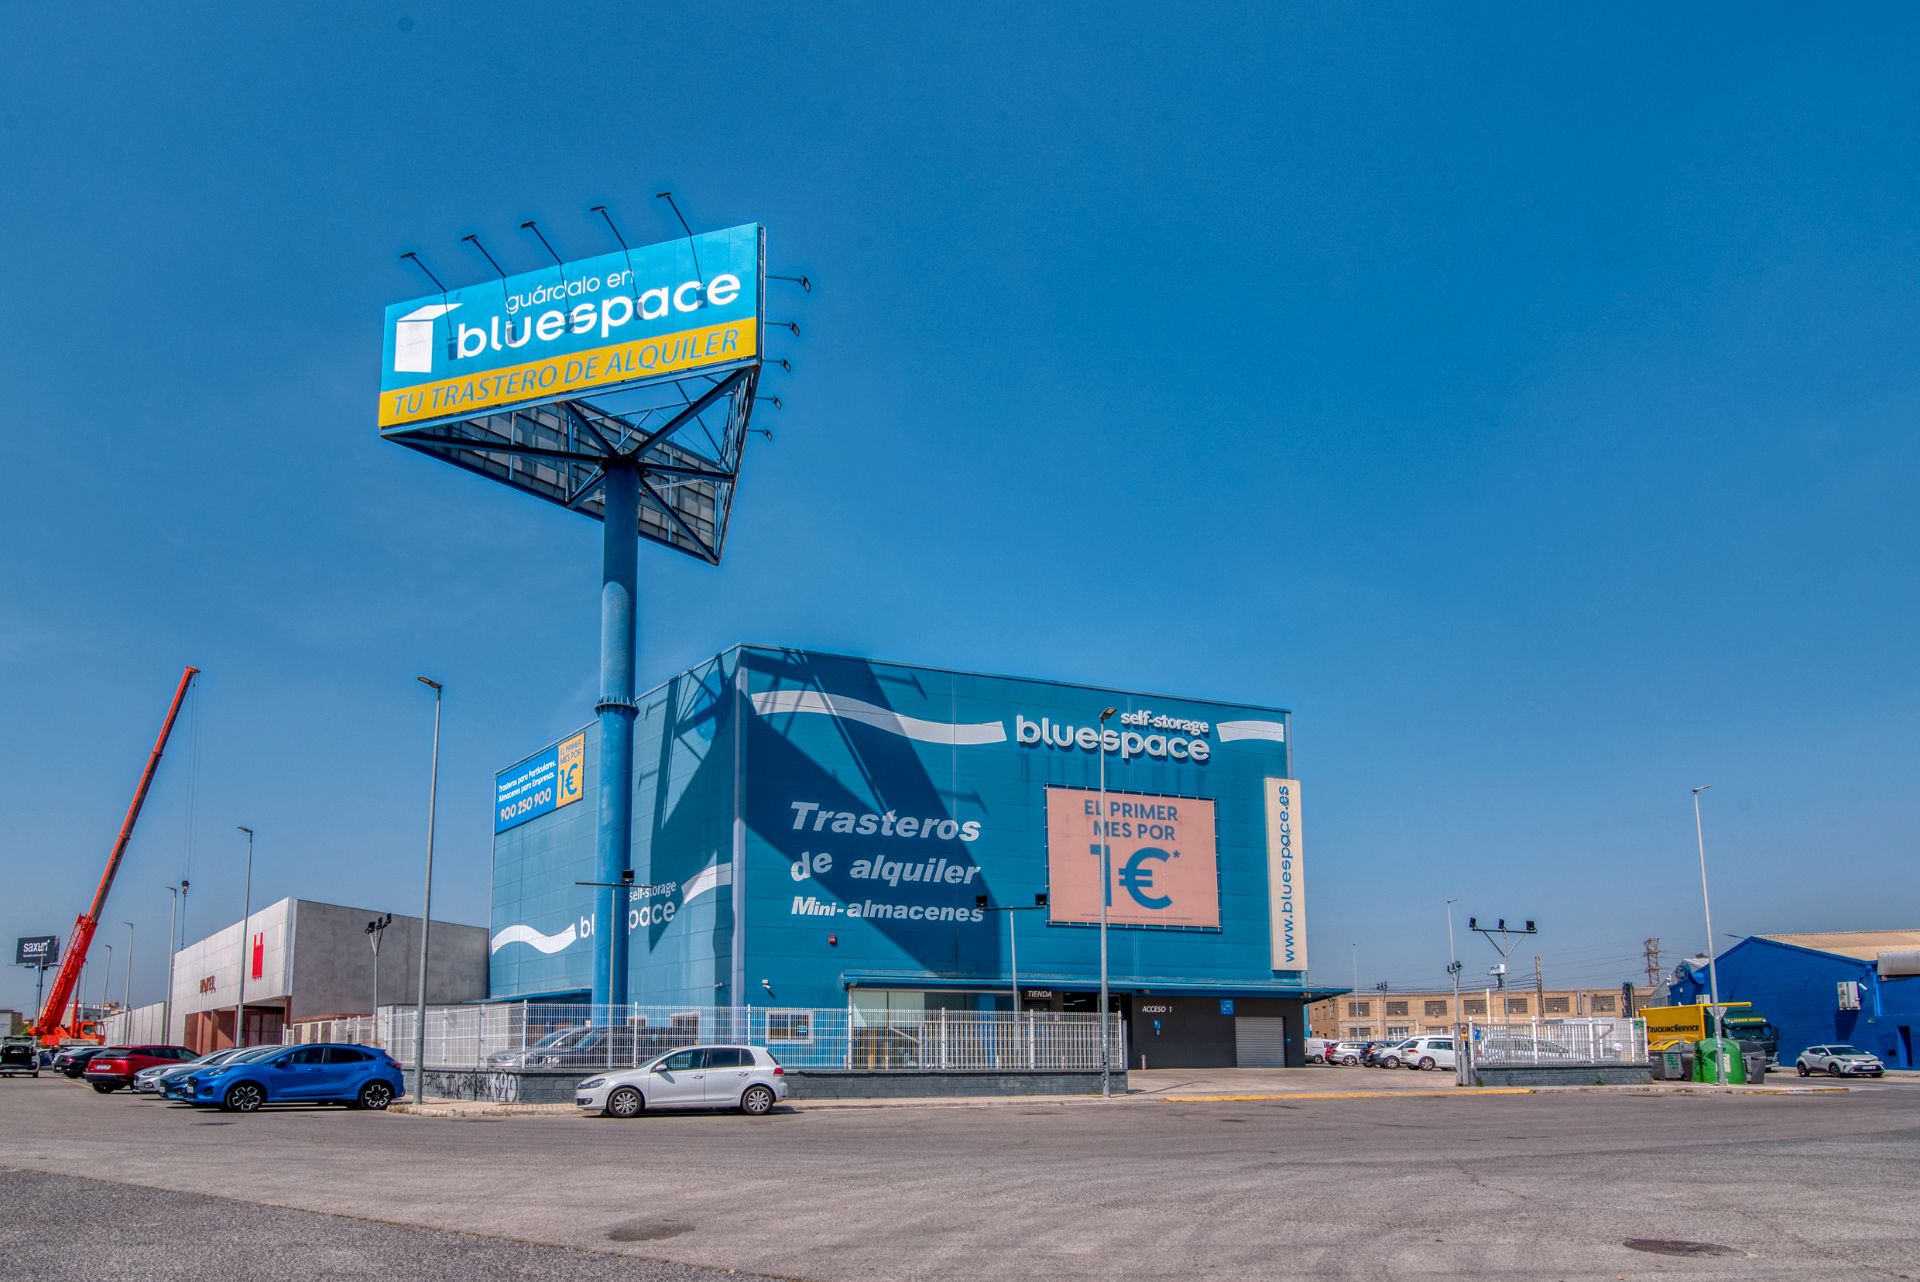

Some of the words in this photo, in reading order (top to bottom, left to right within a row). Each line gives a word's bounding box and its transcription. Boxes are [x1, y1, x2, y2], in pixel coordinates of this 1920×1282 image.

[505, 276, 600, 314] guárdalo
[607, 270, 634, 288] en
[457, 273, 741, 359] bluespace
[394, 391, 424, 416] TU
[431, 365, 557, 409] TRASTERO
[563, 356, 600, 384] DE
[604, 329, 739, 377] ALQUILER
[1016, 714, 1210, 761] bluespace
[1120, 710, 1209, 736] self-storage
[501, 804, 516, 822] 900
[518, 797, 533, 815] 250
[534, 787, 552, 808] 900
[790, 801, 982, 842] Trasteros
[1084, 799, 1102, 816] EL
[1110, 801, 1179, 821] PRIMER
[1093, 821, 1132, 838] MES
[1137, 823, 1175, 840] POR
[790, 851, 833, 882] de
[850, 855, 981, 887] alquiler
[1279, 785, 1296, 963] www.bluespace.es
[629, 881, 677, 901] self-storage
[580, 901, 676, 939] blpace
[1027, 990, 1053, 998] TIENDA
[1142, 1005, 1166, 1013] ACCESO
